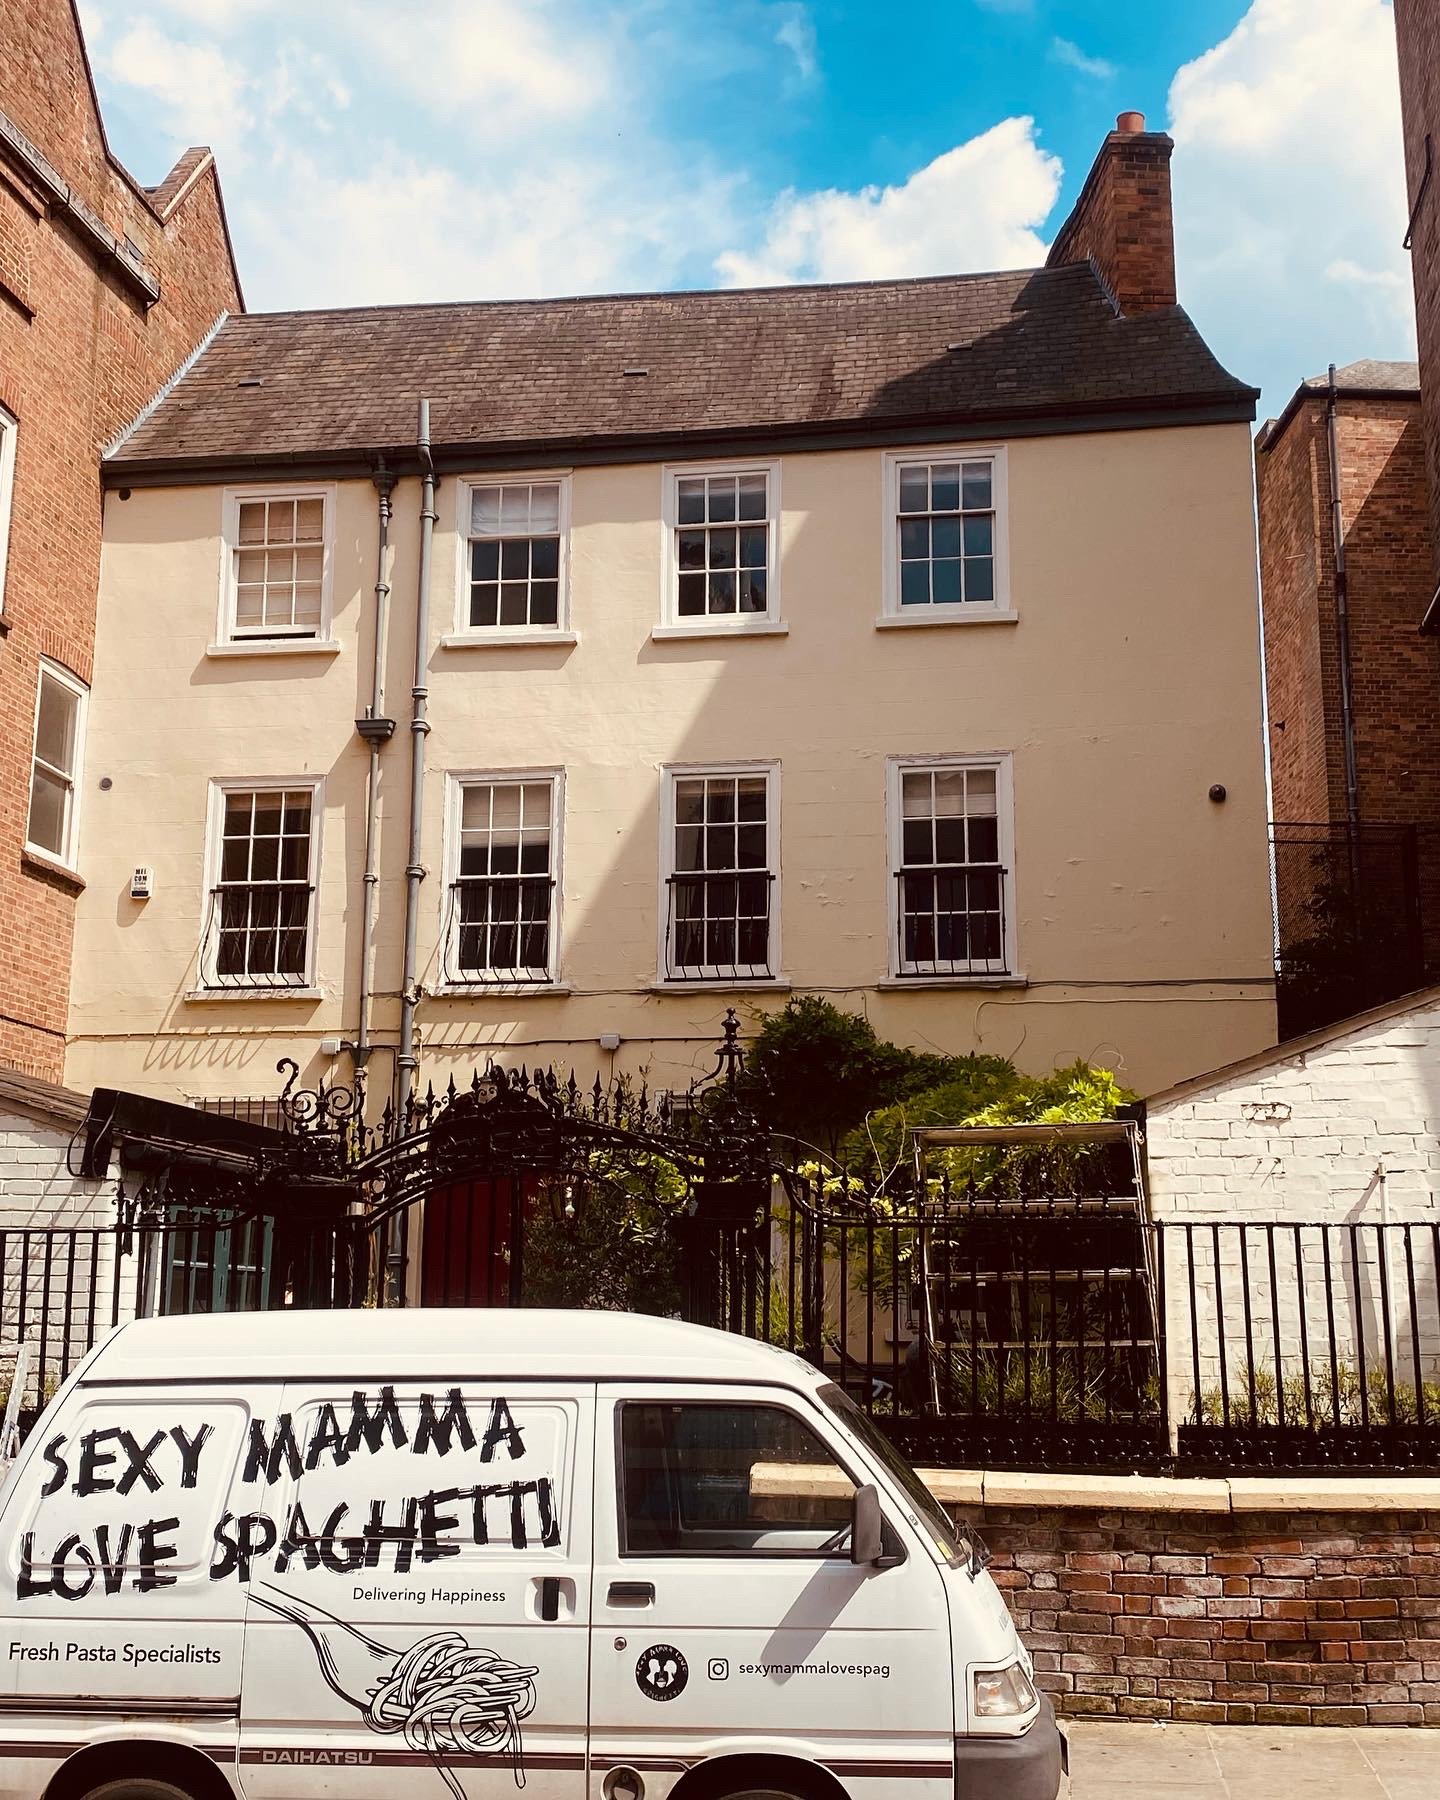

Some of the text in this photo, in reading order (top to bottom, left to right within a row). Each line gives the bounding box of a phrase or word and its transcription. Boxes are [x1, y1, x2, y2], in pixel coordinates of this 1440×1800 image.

[41, 1386, 526, 1497] SEXY MAMMA
[17, 1478, 561, 1600] LOVE SPAGHETTI
[352, 1586, 506, 1605] Delivering Happiness
[9, 1641, 221, 1665] Fresh Pasta Specialists
[739, 1660, 890, 1679] sexymammalovespag
[261, 1750, 374, 1765] DAIHATSU
